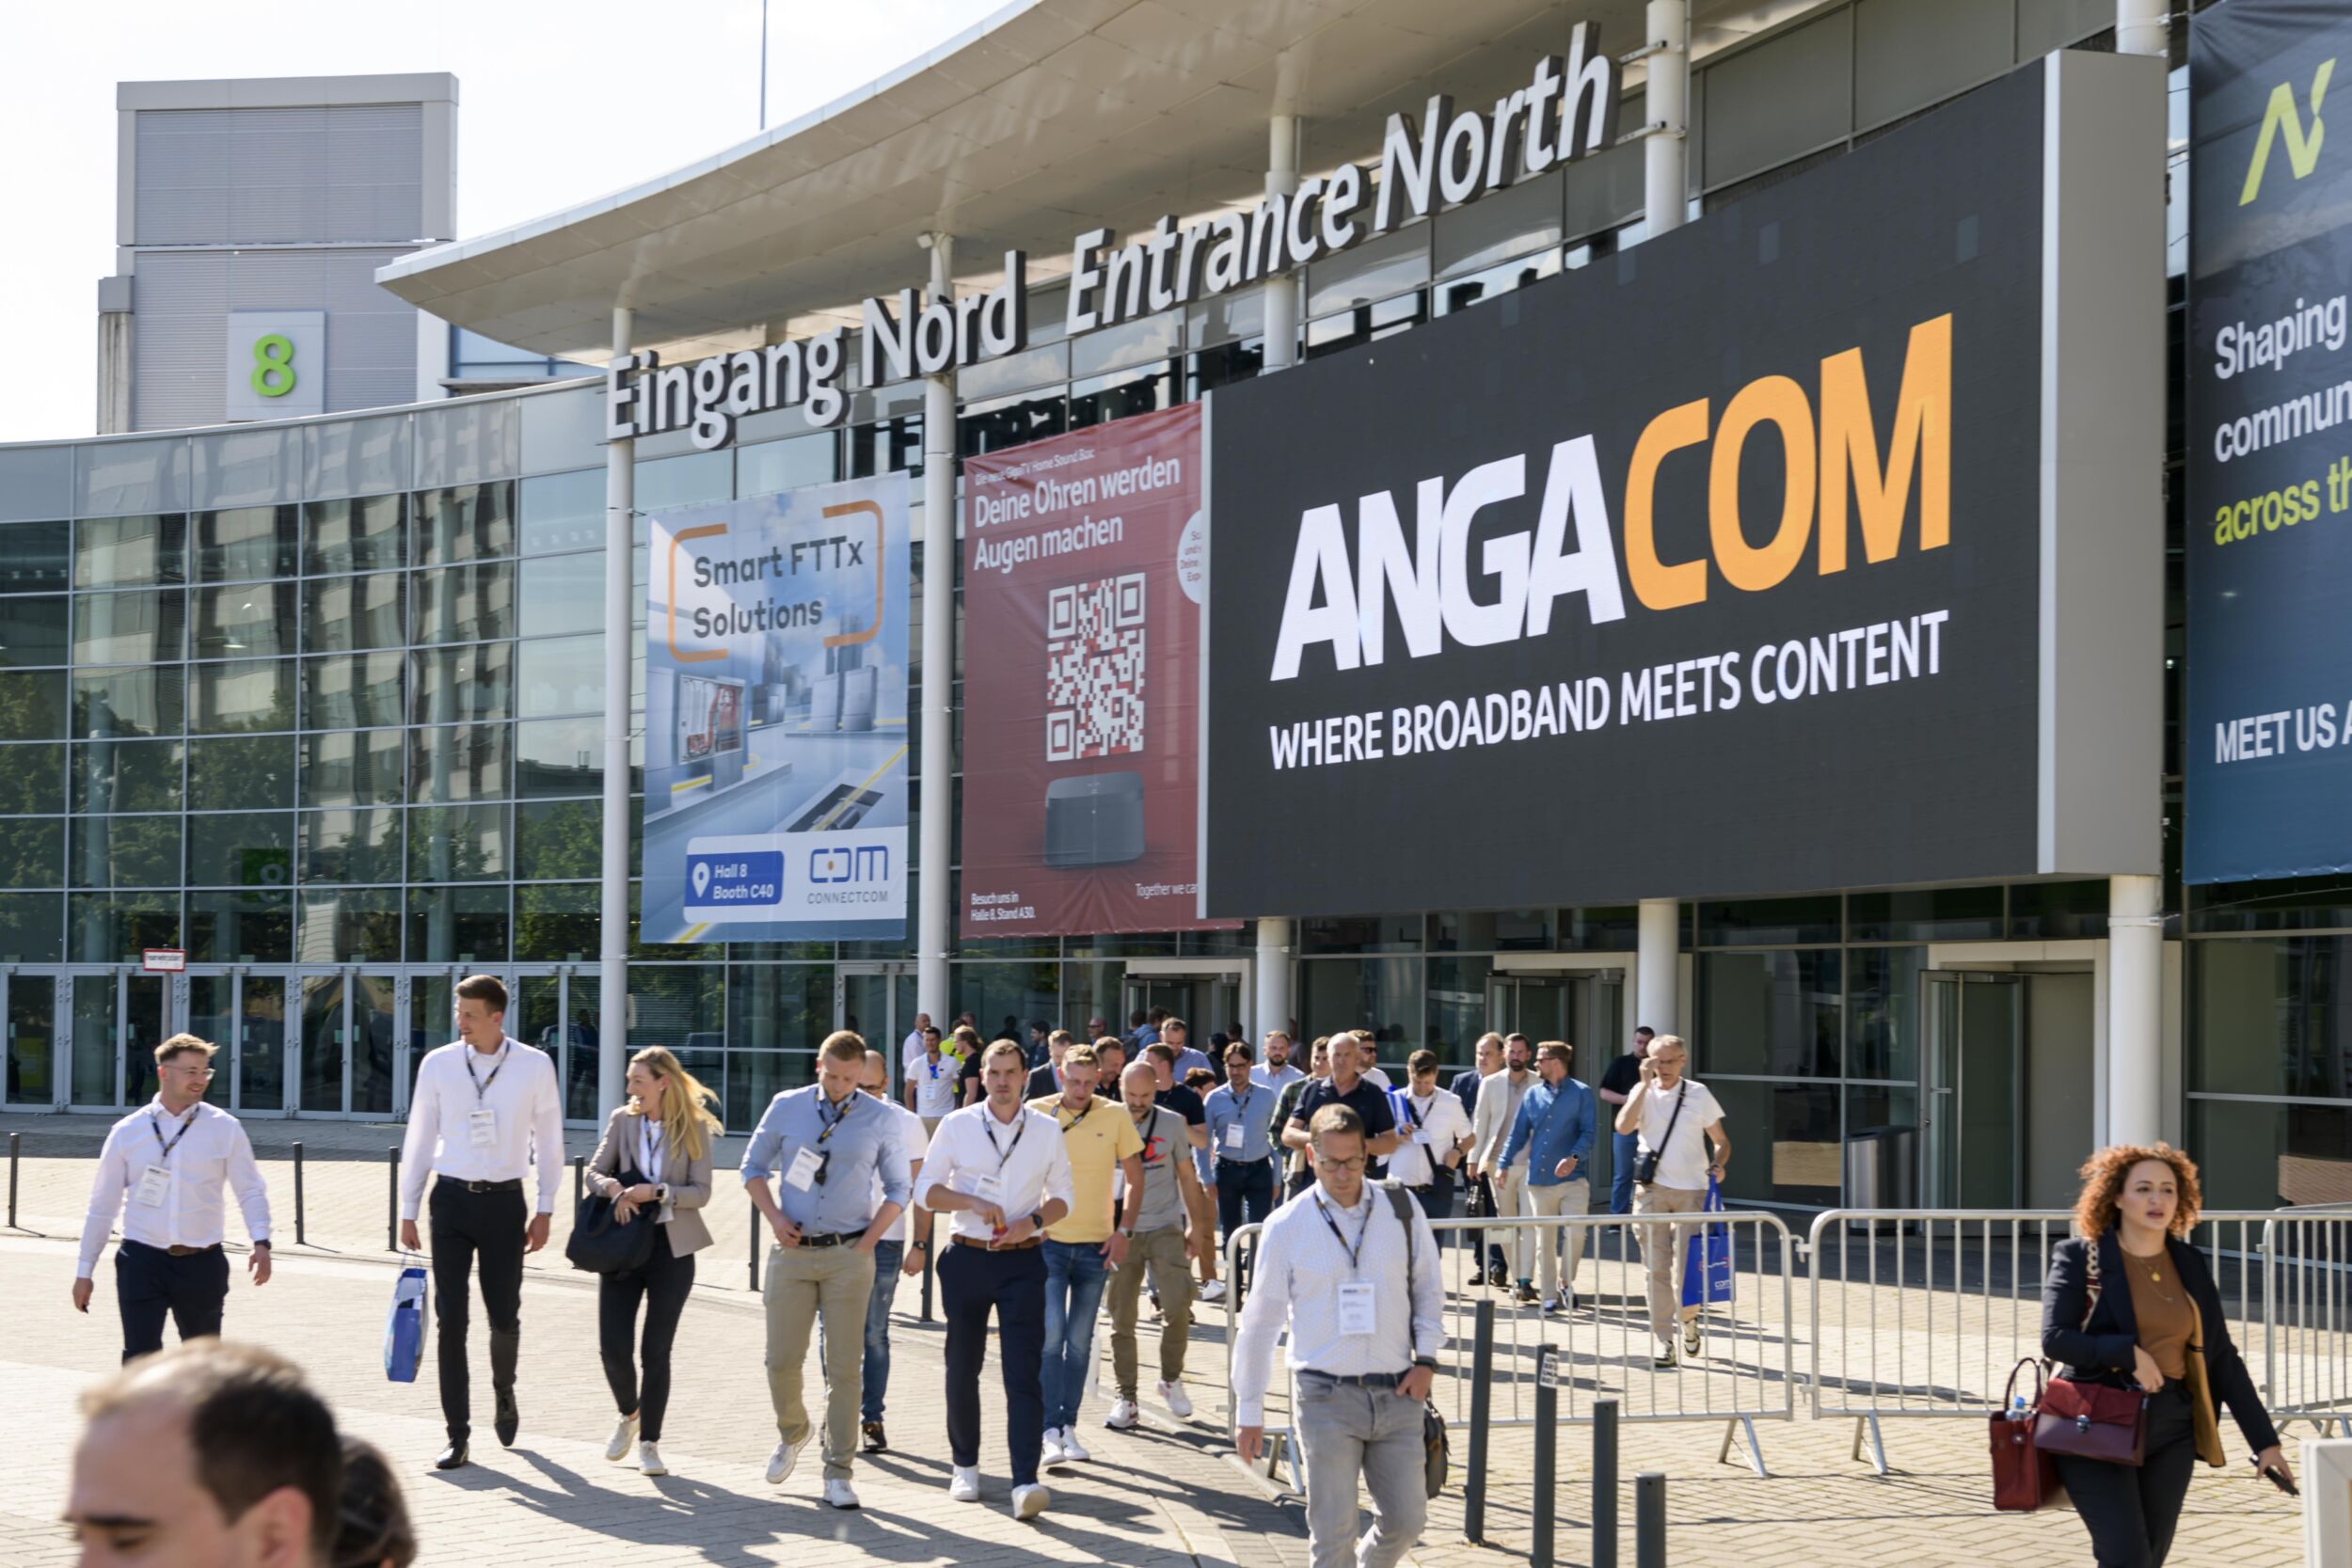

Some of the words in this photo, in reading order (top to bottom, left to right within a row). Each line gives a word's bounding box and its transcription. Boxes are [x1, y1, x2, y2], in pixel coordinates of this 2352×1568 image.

[1065, 162, 1370, 336] Entrance
[1375, 20, 1622, 233] North
[250, 333, 296, 398] 8
[606, 325, 848, 450] Eingang
[863, 249, 1026, 388] Nord
[2215, 294, 2347, 379] Shaping
[2215, 380, 2352, 463] commun
[975, 490, 1030, 528] Deine
[1034, 475, 1096, 515] Ohren
[1099, 455, 1180, 497] werden
[2215, 480, 2321, 546] across
[693, 546, 783, 588] Smart
[791, 535, 865, 576] FTTx
[973, 533, 1038, 574] Augen
[1041, 515, 1123, 558] machen
[692, 597, 823, 639] Solutions
[1270, 711, 1384, 770] WHERE
[1391, 676, 1611, 756] BROADBAND
[1620, 651, 1741, 725] MEETS
[1751, 610, 1949, 705] CONTENT
[2216, 710, 2292, 764] MEET
[2296, 703, 2337, 752] US
[712, 885, 749, 900] Booth
[750, 883, 774, 898] C40
[714, 863, 738, 879] Hall
[739, 863, 748, 878] 8
[807, 891, 888, 904] CONNECTCOM
[1136, 882, 1170, 899] Together
